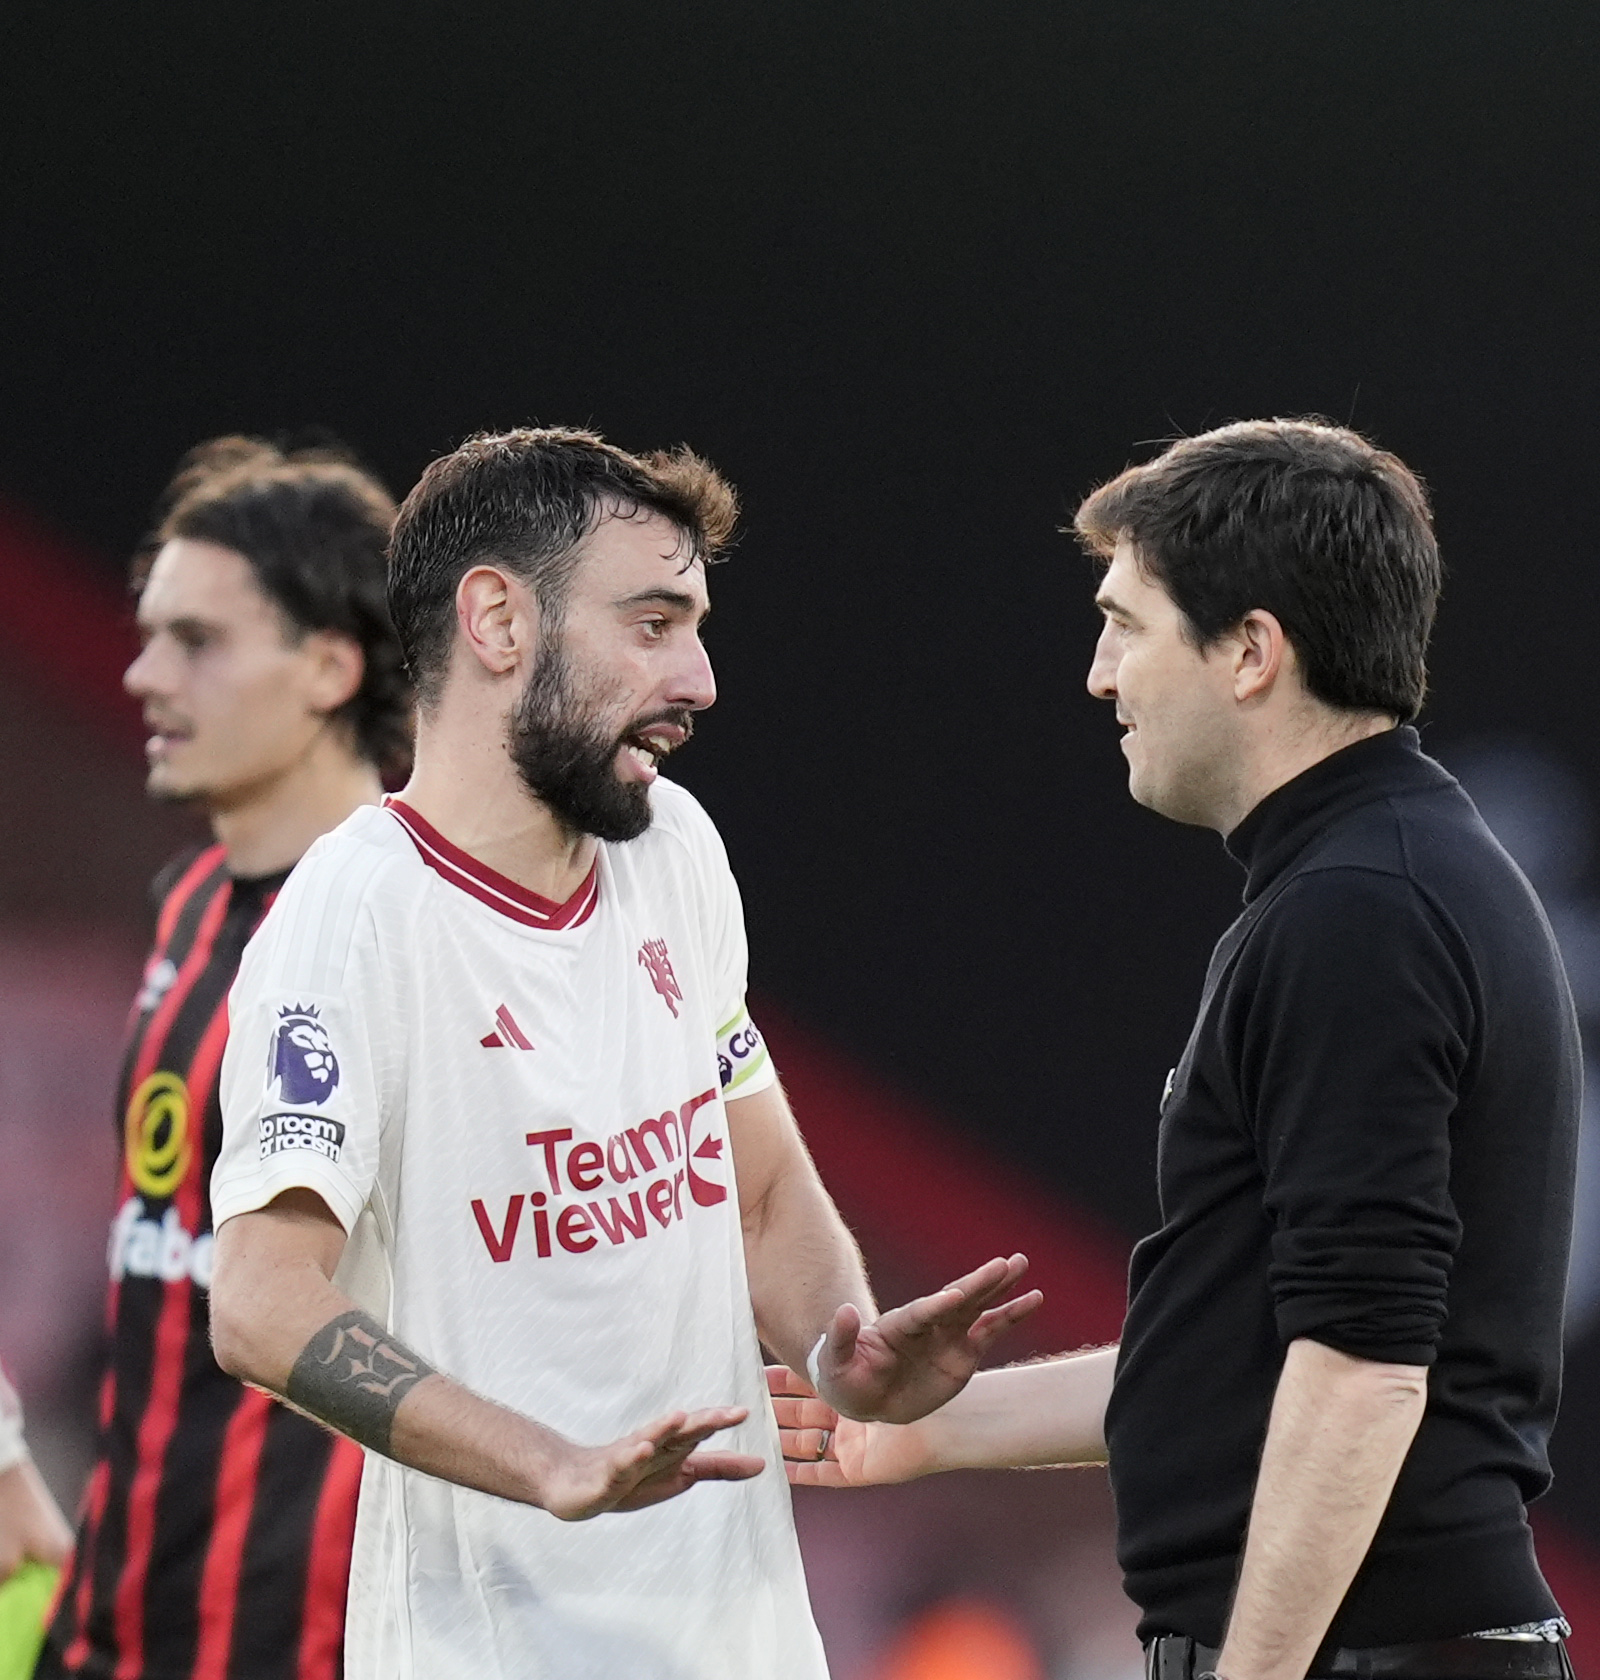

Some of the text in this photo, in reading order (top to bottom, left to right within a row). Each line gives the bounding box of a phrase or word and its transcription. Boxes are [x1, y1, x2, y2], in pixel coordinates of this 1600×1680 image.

[259, 1133, 340, 1163] or racism
[276, 1115, 337, 1142] room
[525, 1110, 681, 1196] Team
[470, 1168, 685, 1263] Viewer
